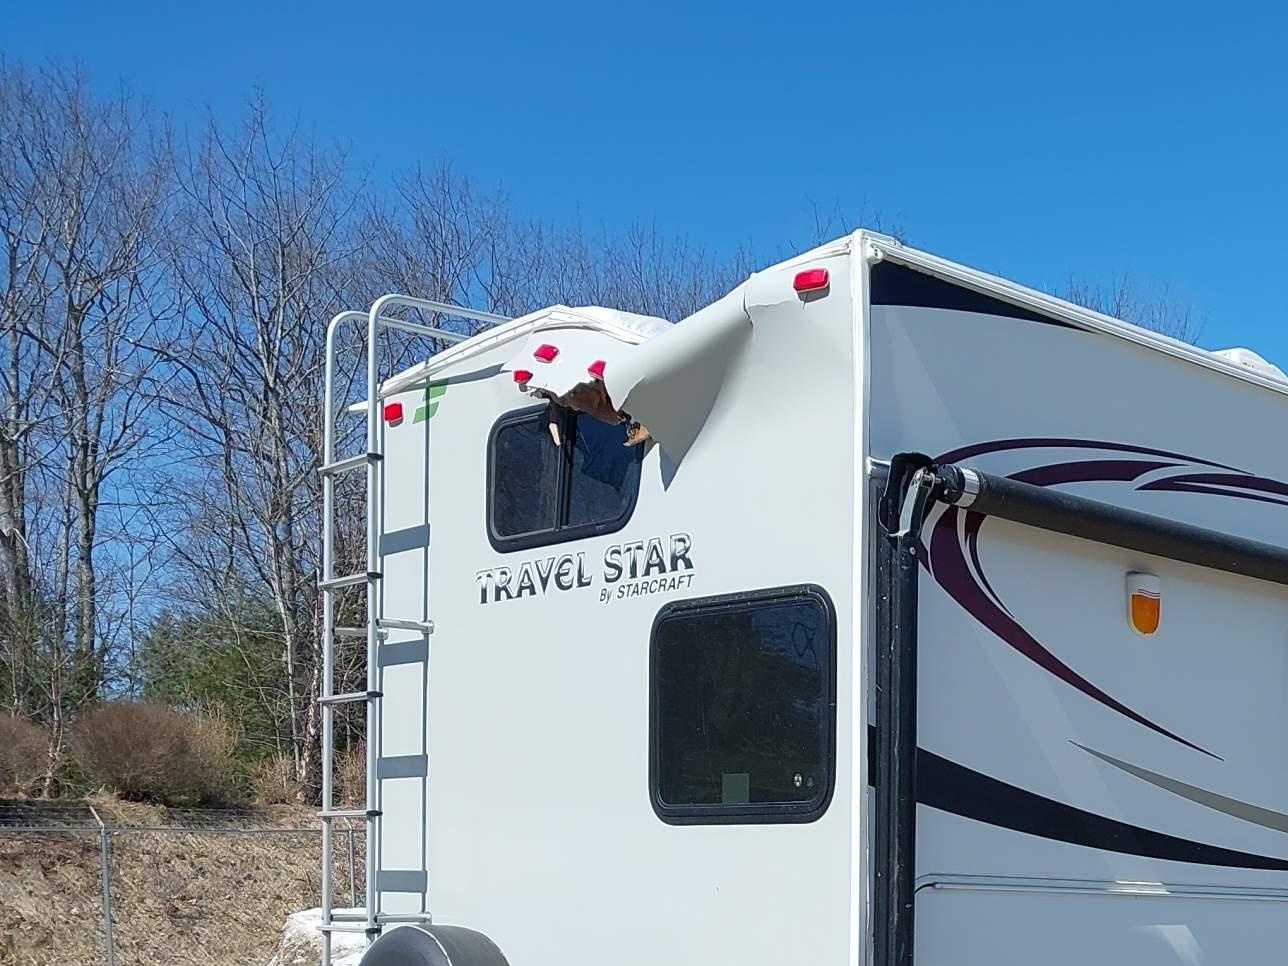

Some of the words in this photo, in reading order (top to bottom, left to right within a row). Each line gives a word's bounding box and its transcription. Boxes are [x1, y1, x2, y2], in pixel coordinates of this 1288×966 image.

[475, 551, 594, 604] TRAVEL
[603, 533, 695, 583] STAR
[600, 588, 612, 604] By
[617, 574, 695, 599] STARCRAFT
